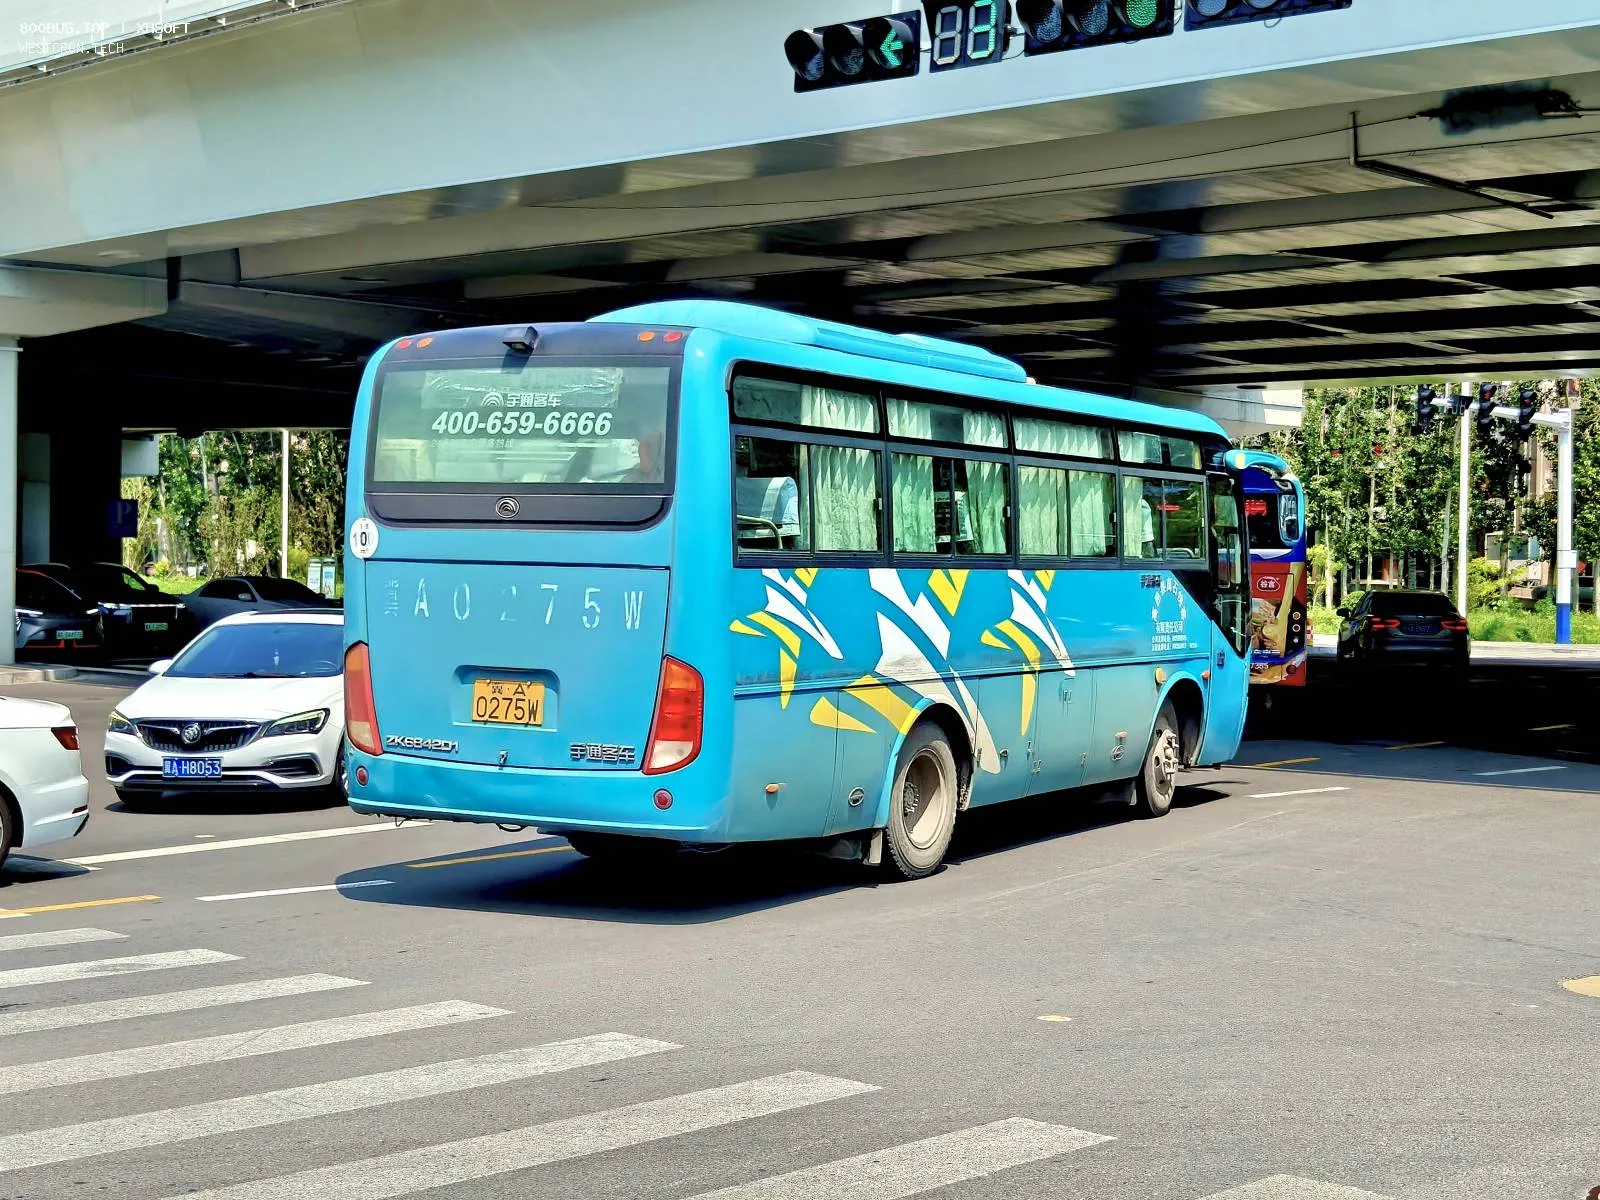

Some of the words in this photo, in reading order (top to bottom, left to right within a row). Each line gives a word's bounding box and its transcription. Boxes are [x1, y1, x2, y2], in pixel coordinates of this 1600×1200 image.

[506, 393, 562, 408] 宇通客车
[431, 411, 613, 436] 400-659-6666
[476, 695, 539, 722] 0275W
[570, 743, 635, 763] 宇通客车
